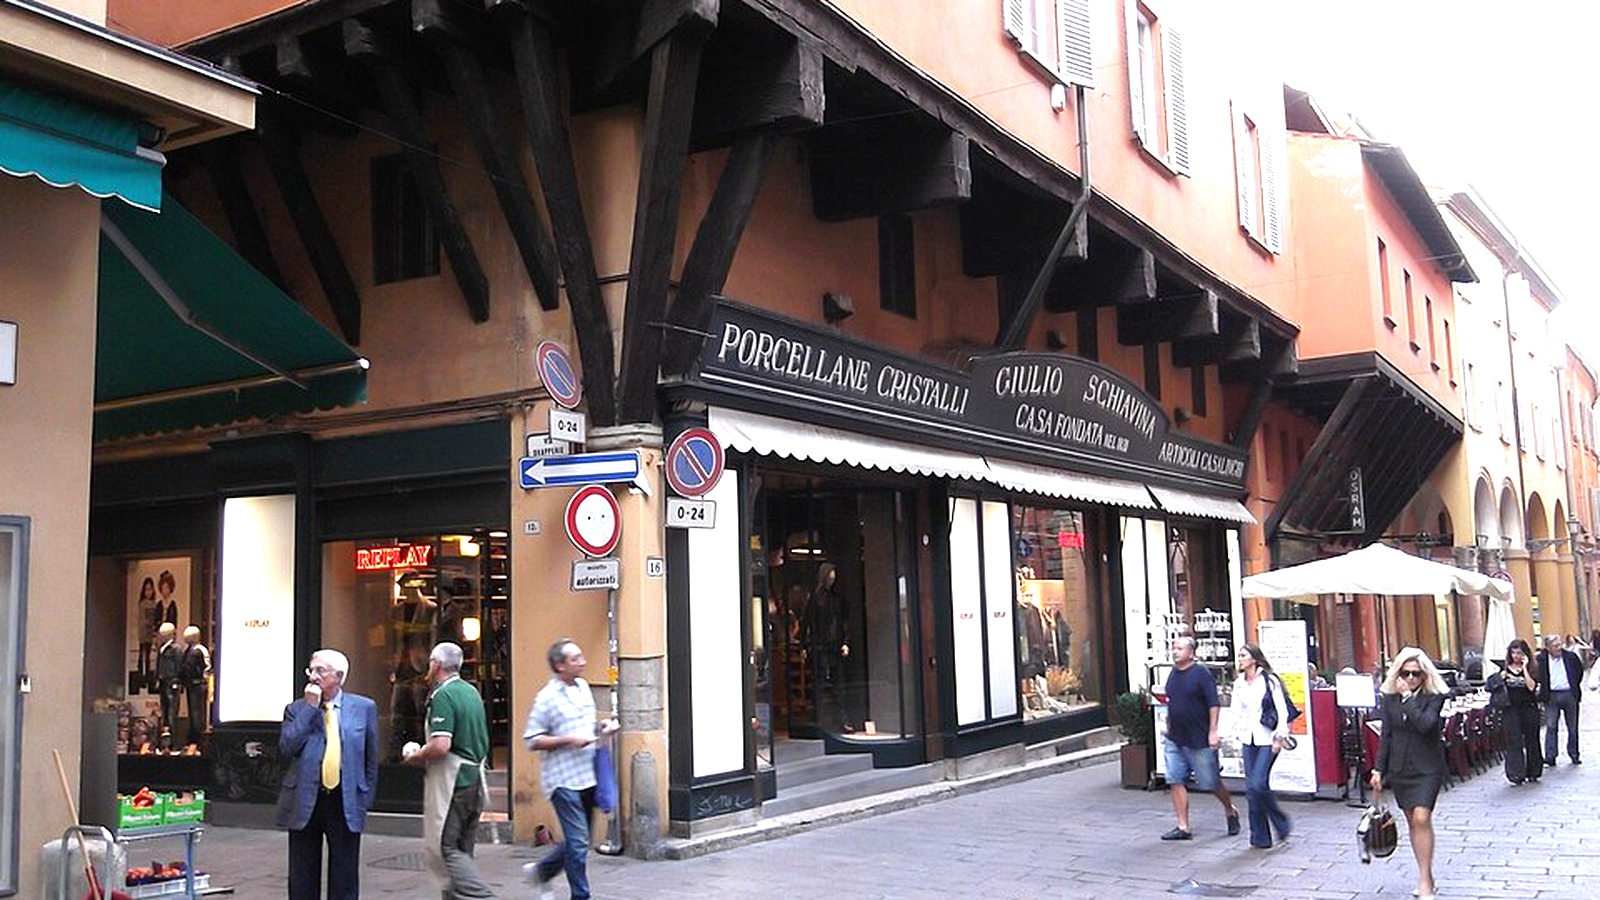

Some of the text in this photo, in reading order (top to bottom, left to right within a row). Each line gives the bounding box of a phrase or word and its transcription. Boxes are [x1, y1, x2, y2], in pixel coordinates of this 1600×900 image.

[717, 322, 970, 415] PORCELLANE CRISTALLI
[995, 365, 1158, 440] GIULIO SCHIAVINA
[1015, 403, 1054, 435] CASA
[1053, 412, 1104, 447] FONDATA
[1157, 441, 1202, 469] ARTICOLI
[1349, 470, 1362, 528] OSRAM
[356, 545, 431, 570] REPLAY
[650, 561, 661, 574] 16
[576, 575, 616, 586] autorizzati
